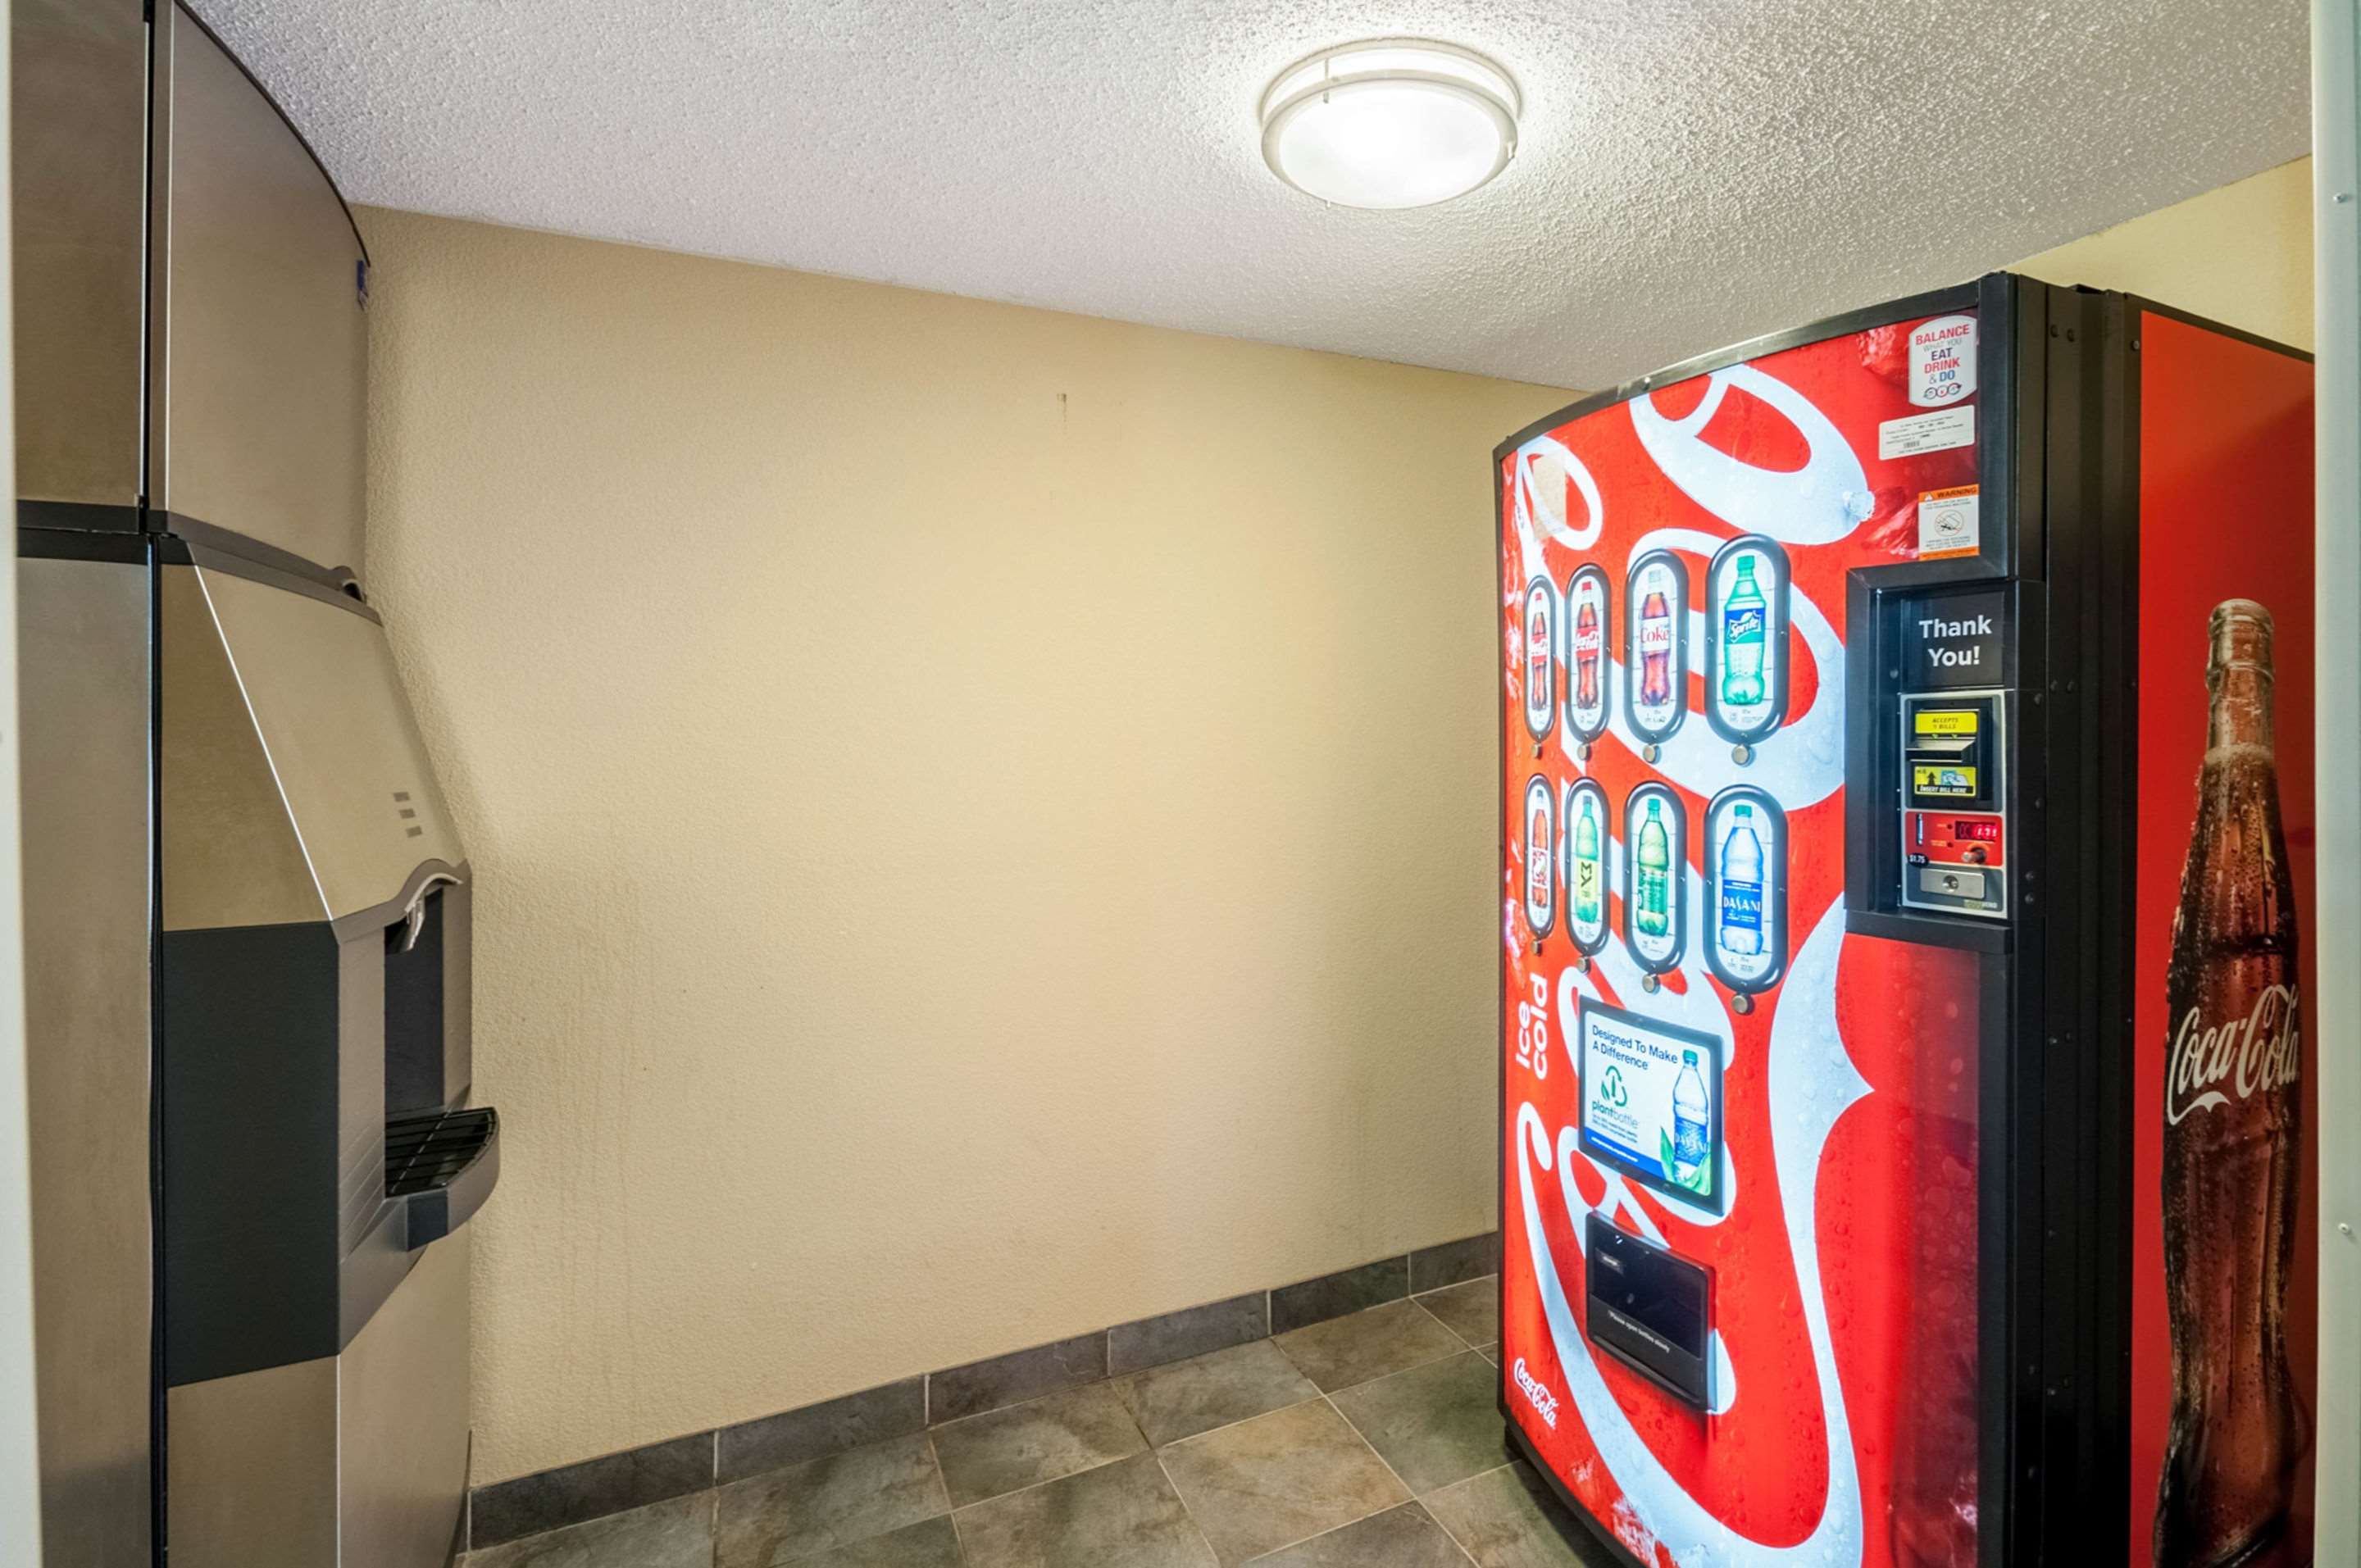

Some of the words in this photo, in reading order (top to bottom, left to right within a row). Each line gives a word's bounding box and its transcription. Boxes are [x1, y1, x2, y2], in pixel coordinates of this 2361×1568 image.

[1915, 324, 1971, 346] BALANCE
[1947, 338, 1963, 346] YOU
[1931, 348, 1954, 361] EAT
[1924, 357, 1961, 374] DRINK
[1928, 374, 1937, 385] &
[1939, 369, 1956, 382] DO
[1936, 486, 1977, 499] WARNING
[1729, 616, 1759, 639] Sprite
[1918, 615, 1993, 639] Thank
[1640, 628, 1669, 645] Coke
[1927, 645, 1981, 667] You!
[1908, 853, 1927, 865] $1.75
[1723, 895, 1761, 913] DASANI
[1530, 972, 1548, 1080] cold
[1591, 1024, 1633, 1049] Designed
[1635, 1039, 1647, 1054] To
[1649, 1046, 1678, 1065] Make
[1592, 1041, 1599, 1052] A
[1600, 1044, 1649, 1070] Difference
